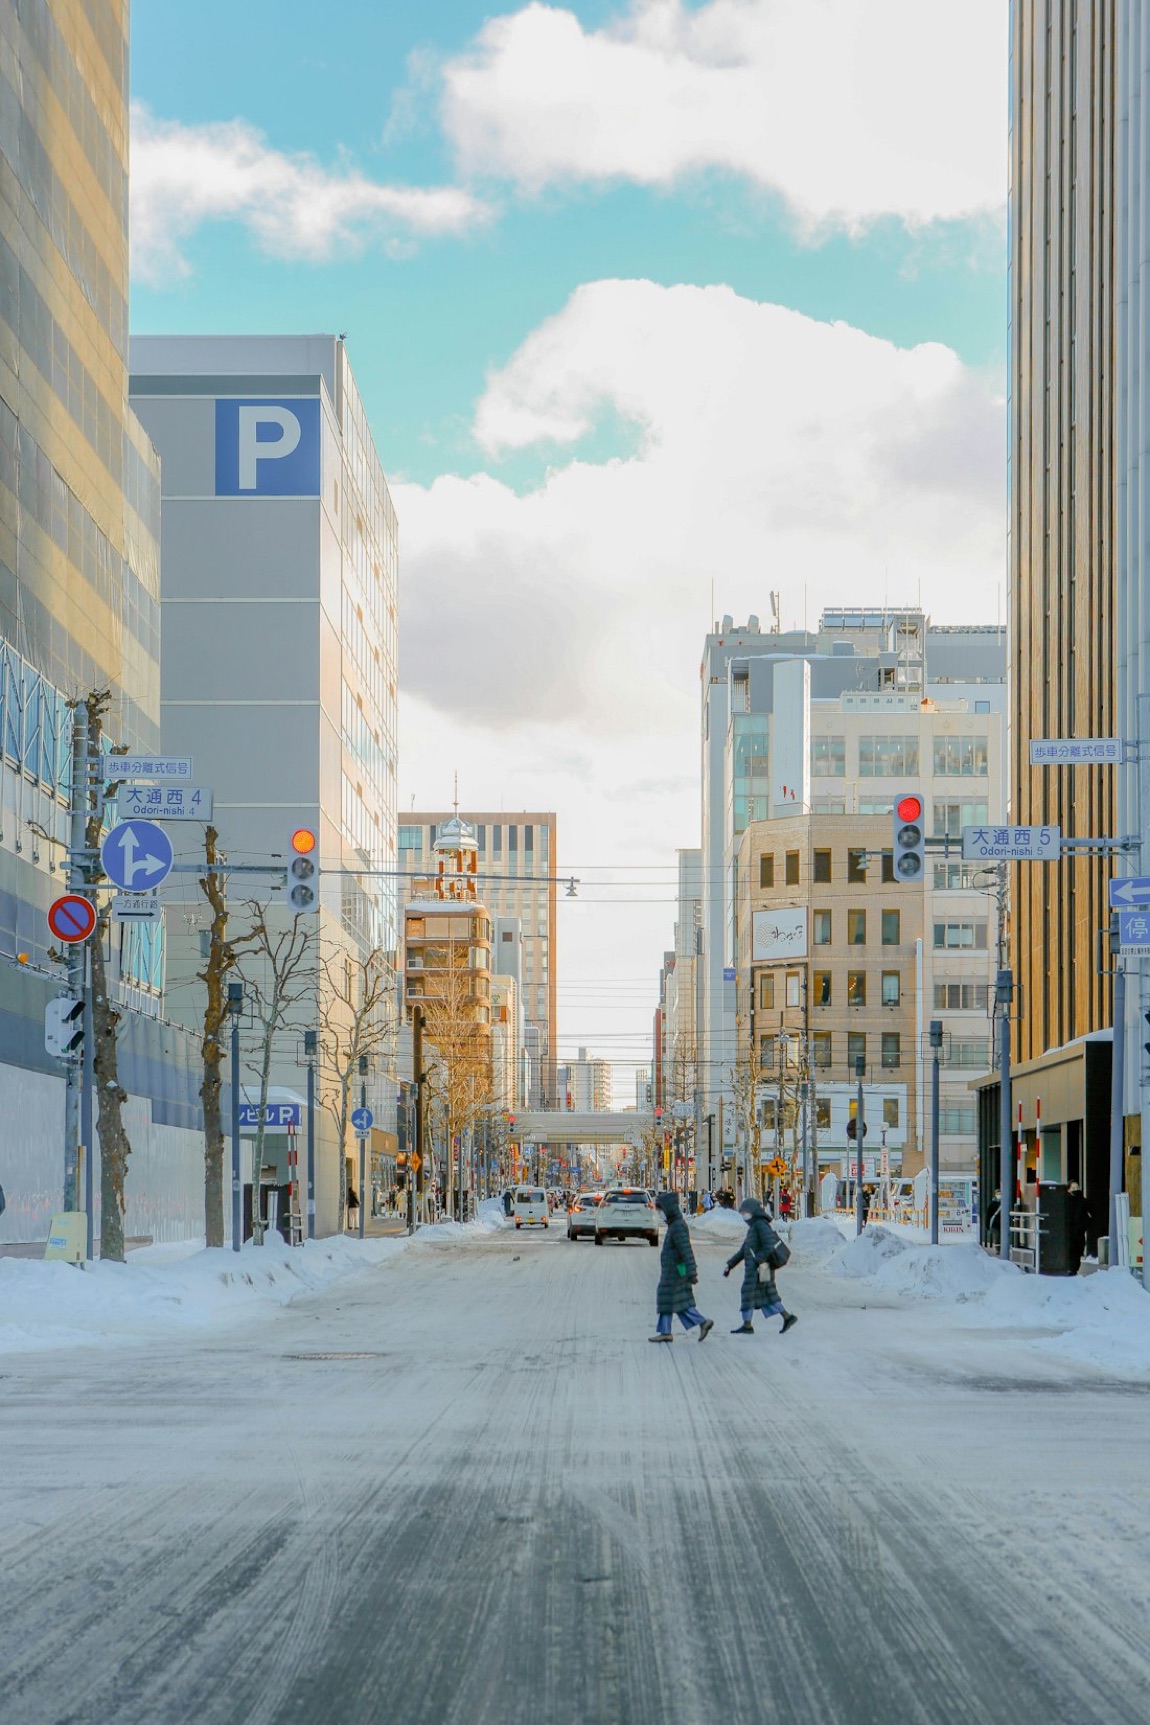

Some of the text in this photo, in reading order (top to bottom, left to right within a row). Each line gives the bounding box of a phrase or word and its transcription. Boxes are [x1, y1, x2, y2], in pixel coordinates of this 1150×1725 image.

[238, 405, 302, 490] P
[1035, 744, 1117, 758] 歩車分離式信号
[108, 761, 189, 775] 歩車分離式信号
[126, 787, 202, 806] 大通西 4
[133, 805, 195, 816] Odori-nishi 4
[972, 828, 1051, 846] 大通西 5
[980, 846, 1044, 856] Odori-nishi 5
[115, 899, 158, 909] 一方通行路
[1125, 916, 1148, 939] 停
[279, 1106, 294, 1124] P
